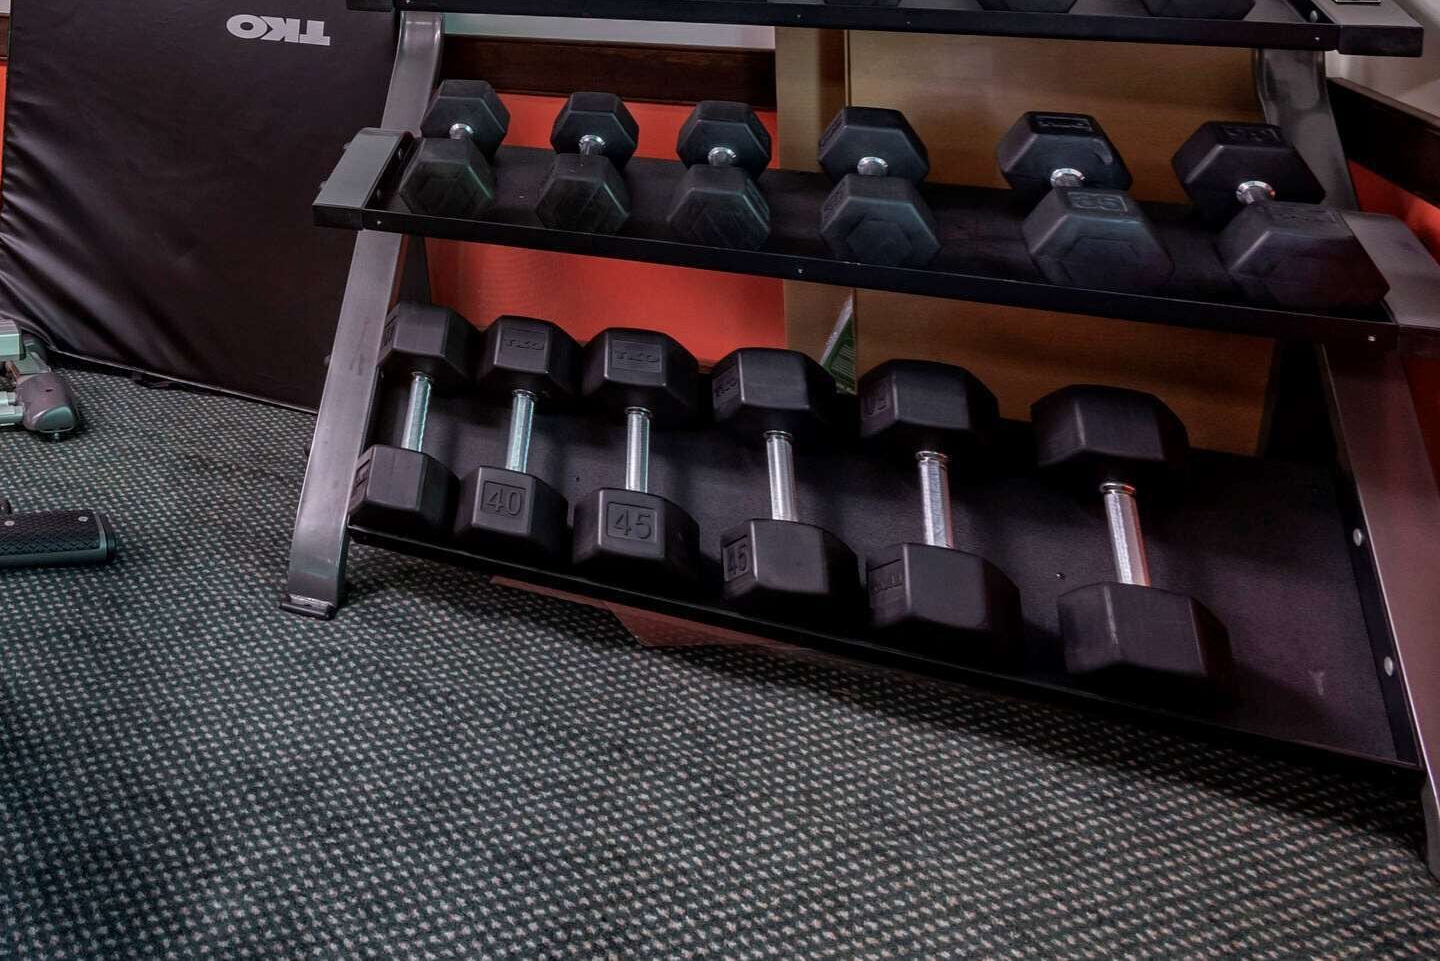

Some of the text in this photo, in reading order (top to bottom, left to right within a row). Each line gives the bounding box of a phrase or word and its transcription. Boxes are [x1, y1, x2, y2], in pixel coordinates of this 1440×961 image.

[226, 13, 331, 46] TKO
[487, 488, 524, 517] 40
[613, 508, 653, 540] 45
